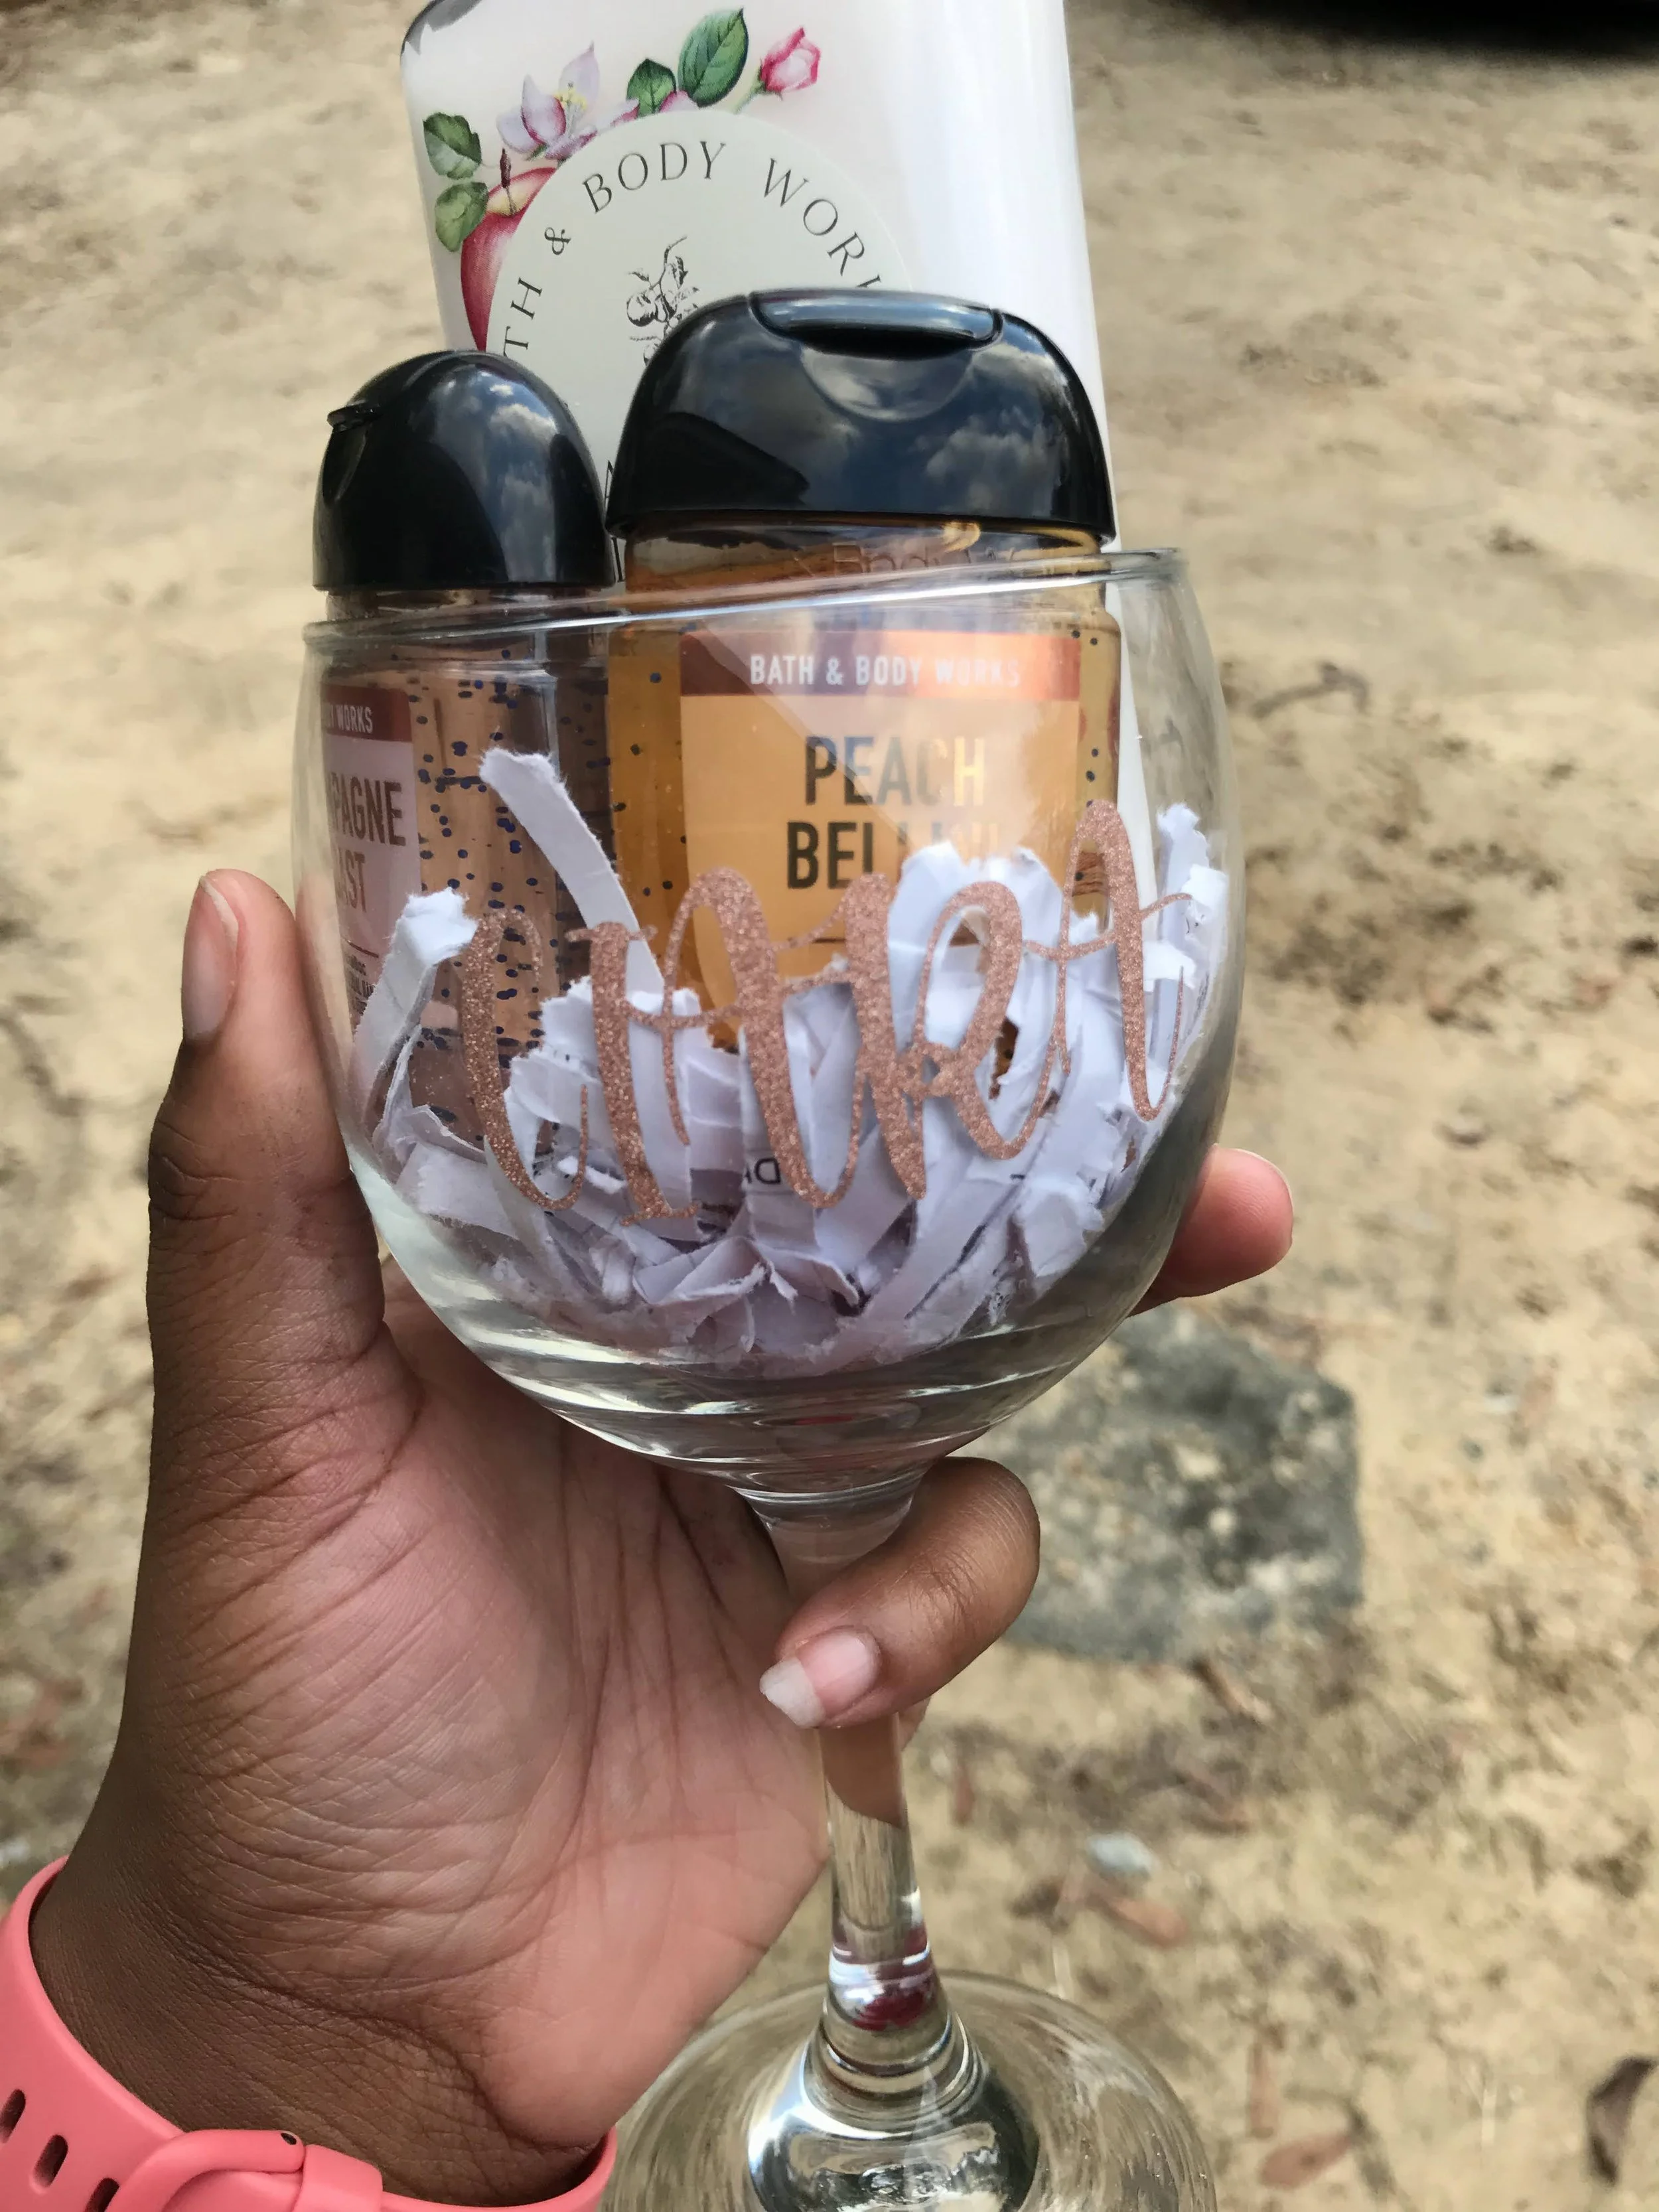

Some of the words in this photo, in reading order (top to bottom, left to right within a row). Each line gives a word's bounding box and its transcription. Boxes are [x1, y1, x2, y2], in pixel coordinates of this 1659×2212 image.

[502, 277, 542, 356] TH
[544, 227, 571, 255] &
[582, 141, 726, 213] BODY
[750, 654, 814, 686] BATH
[826, 658, 844, 686] &
[857, 656, 922, 687] BODY
[936, 657, 1021, 688] WORKS
[337, 704, 373, 733] WORKS
[805, 735, 985, 806] PEACH
[331, 772, 407, 846] PAGNE
[339, 846, 367, 913] AST
